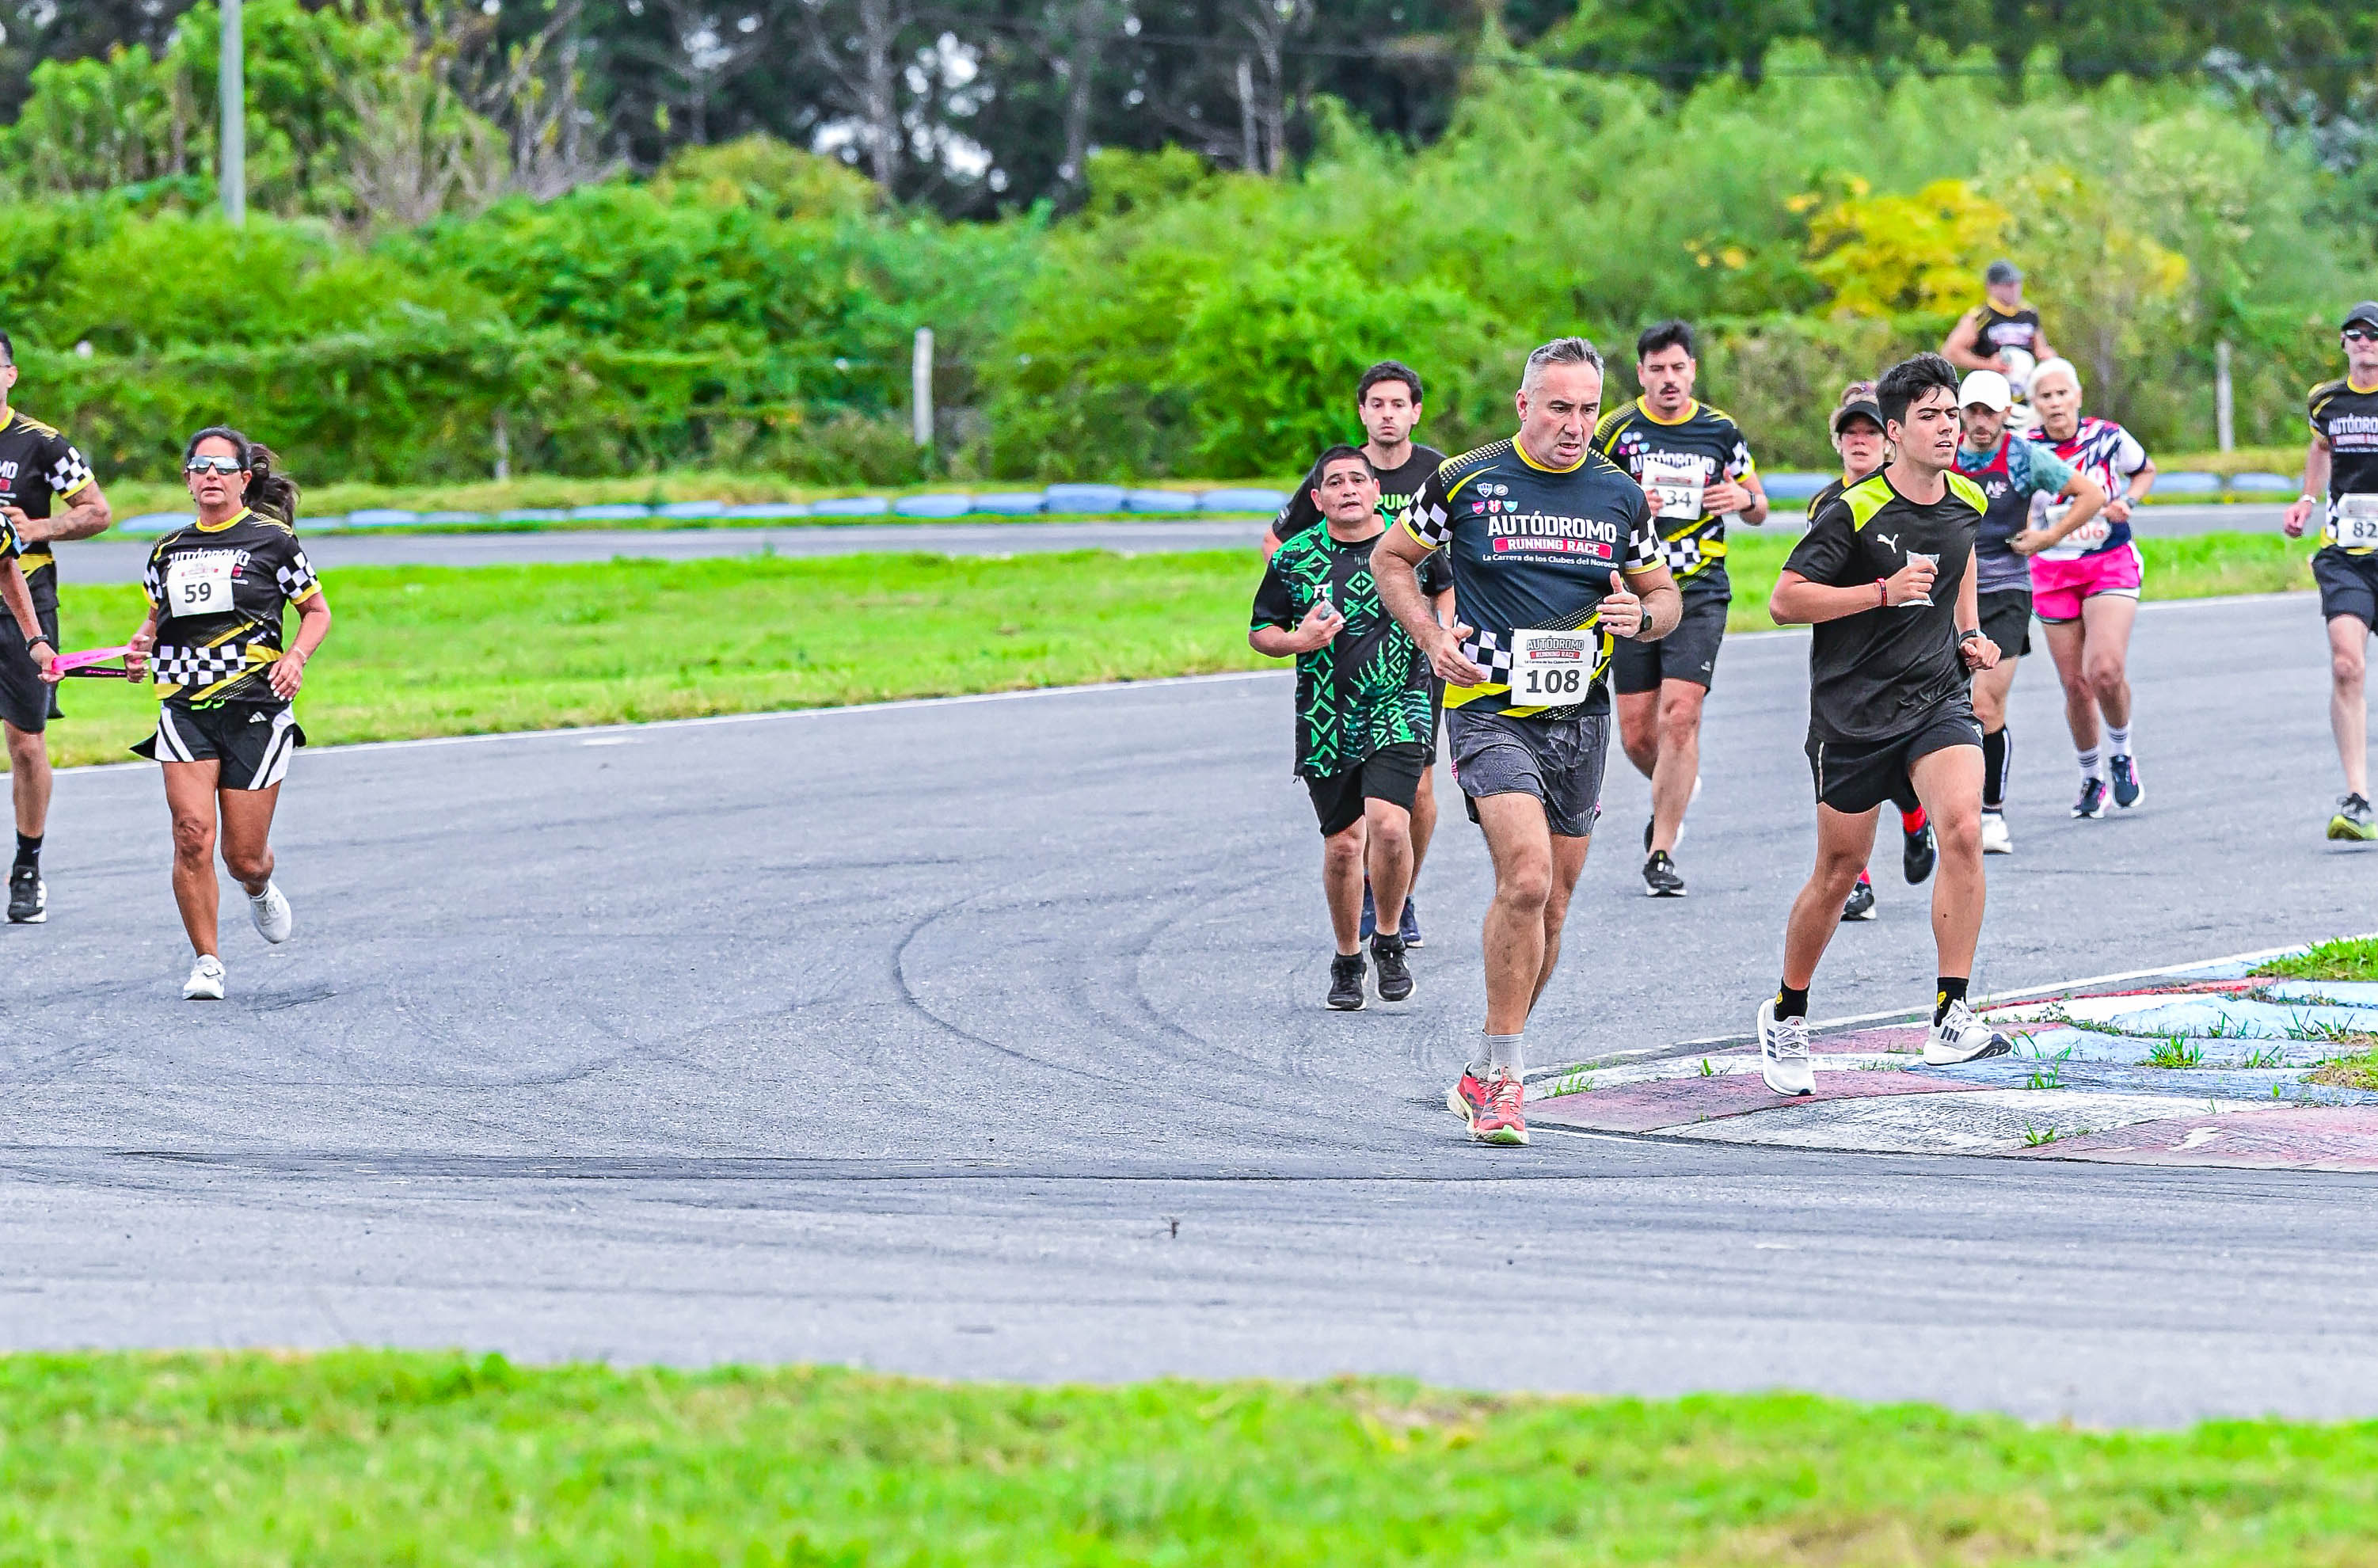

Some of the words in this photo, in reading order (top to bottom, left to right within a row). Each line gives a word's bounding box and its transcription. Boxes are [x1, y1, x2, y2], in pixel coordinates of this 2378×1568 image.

[1374, 493, 1411, 510] PUM
[1654, 489, 1692, 507] 34
[1487, 511, 1617, 543] AUTÓDROMO
[2353, 522, 2378, 539] 82
[1507, 538, 1564, 551] RUNNING
[1566, 540, 1600, 555] RACE
[1535, 554, 1547, 563] los
[1547, 555, 1575, 565] Clubes
[185, 582, 211, 603] 59
[1526, 669, 1580, 694] 108
